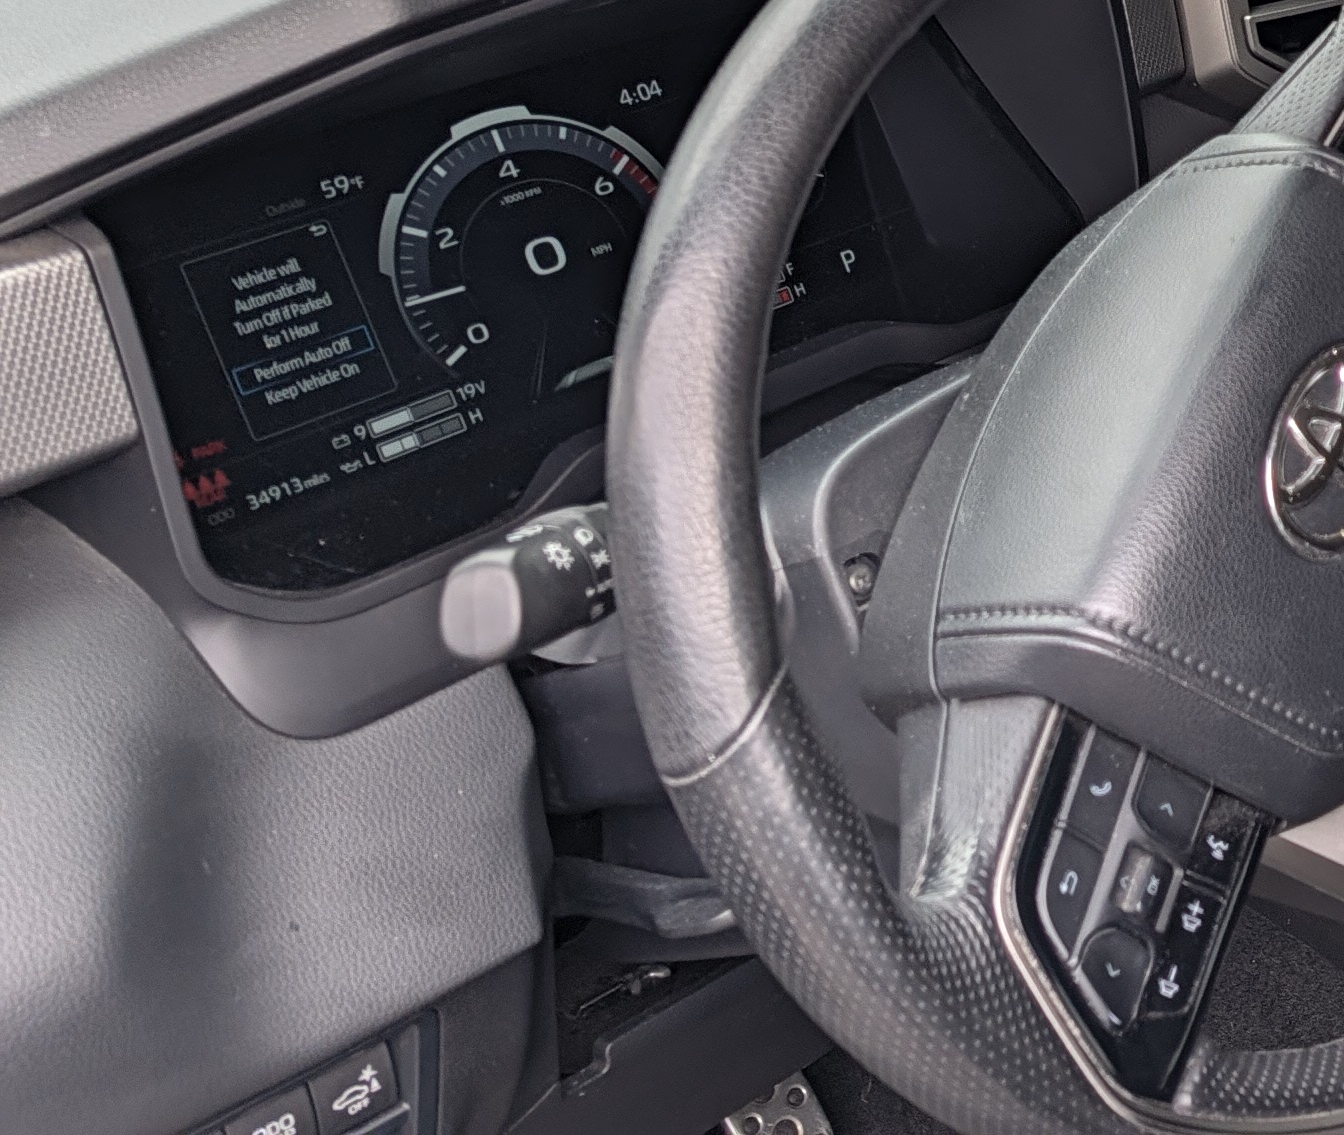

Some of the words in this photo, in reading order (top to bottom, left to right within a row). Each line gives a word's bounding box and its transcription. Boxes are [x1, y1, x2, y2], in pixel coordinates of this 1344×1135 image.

[619, 79, 663, 106] 4:04
[498, 158, 521, 179] 4
[594, 175, 615, 197] 6
[435, 226, 460, 251] 2
[590, 242, 614, 257] MPH
[524, 235, 568, 277] 0
[840, 249, 856, 274] P
[231, 266, 277, 290] Vehicle
[277, 257, 302, 276] will
[234, 276, 317, 314] Automatically
[793, 282, 807, 297] H
[233, 319, 263, 336] Turn
[261, 309, 284, 326] Off
[291, 291, 333, 317] Parked
[262, 334, 282, 349] for
[288, 321, 320, 340] Hour
[466, 322, 490, 345] 0
[253, 357, 304, 382] Perform
[303, 346, 333, 365] Auto
[331, 336, 352, 355] Off
[264, 386, 299, 405] Keep
[295, 368, 341, 393] Vehicle
[339, 363, 361, 379] On
[456, 379, 486, 402] 19V
[467, 407, 485, 425] H
[353, 423, 367, 441] 9
[362, 451, 377, 466] L
[245, 476, 305, 511] 34913
